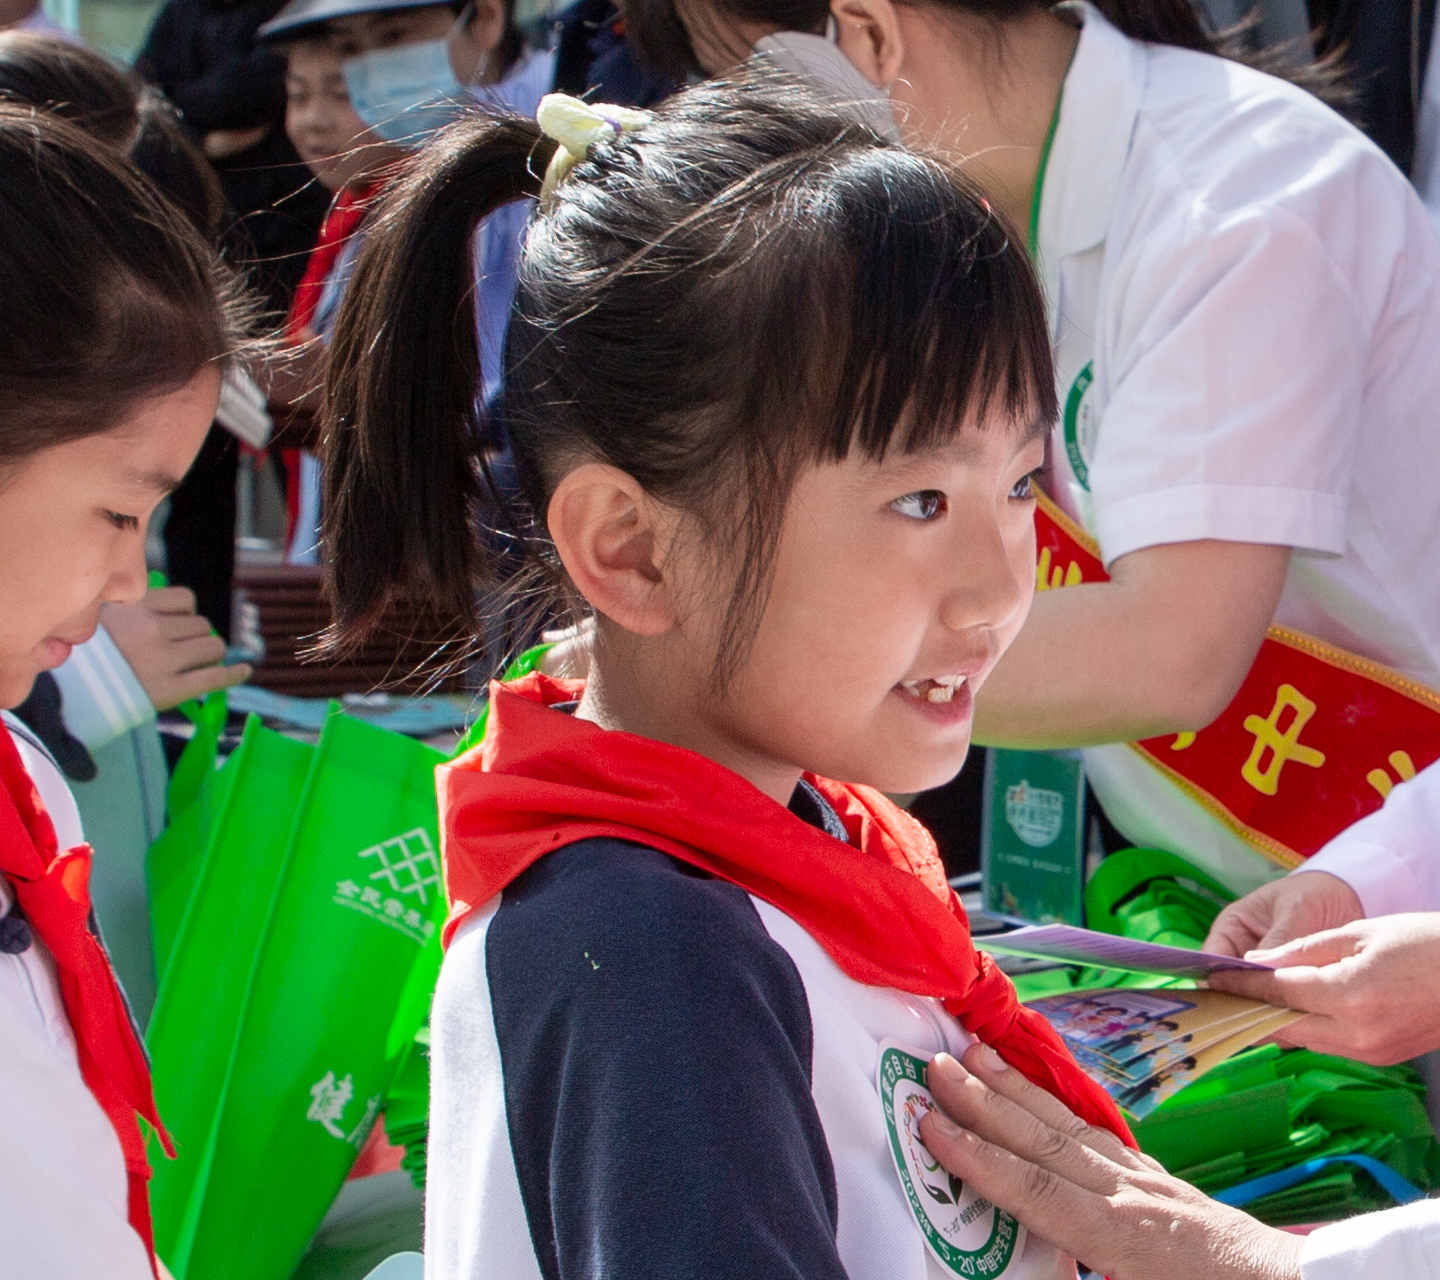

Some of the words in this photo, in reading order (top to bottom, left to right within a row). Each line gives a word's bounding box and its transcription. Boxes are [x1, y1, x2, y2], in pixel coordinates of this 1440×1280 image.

[881, 1052, 927, 1126] 内蒙古自治
